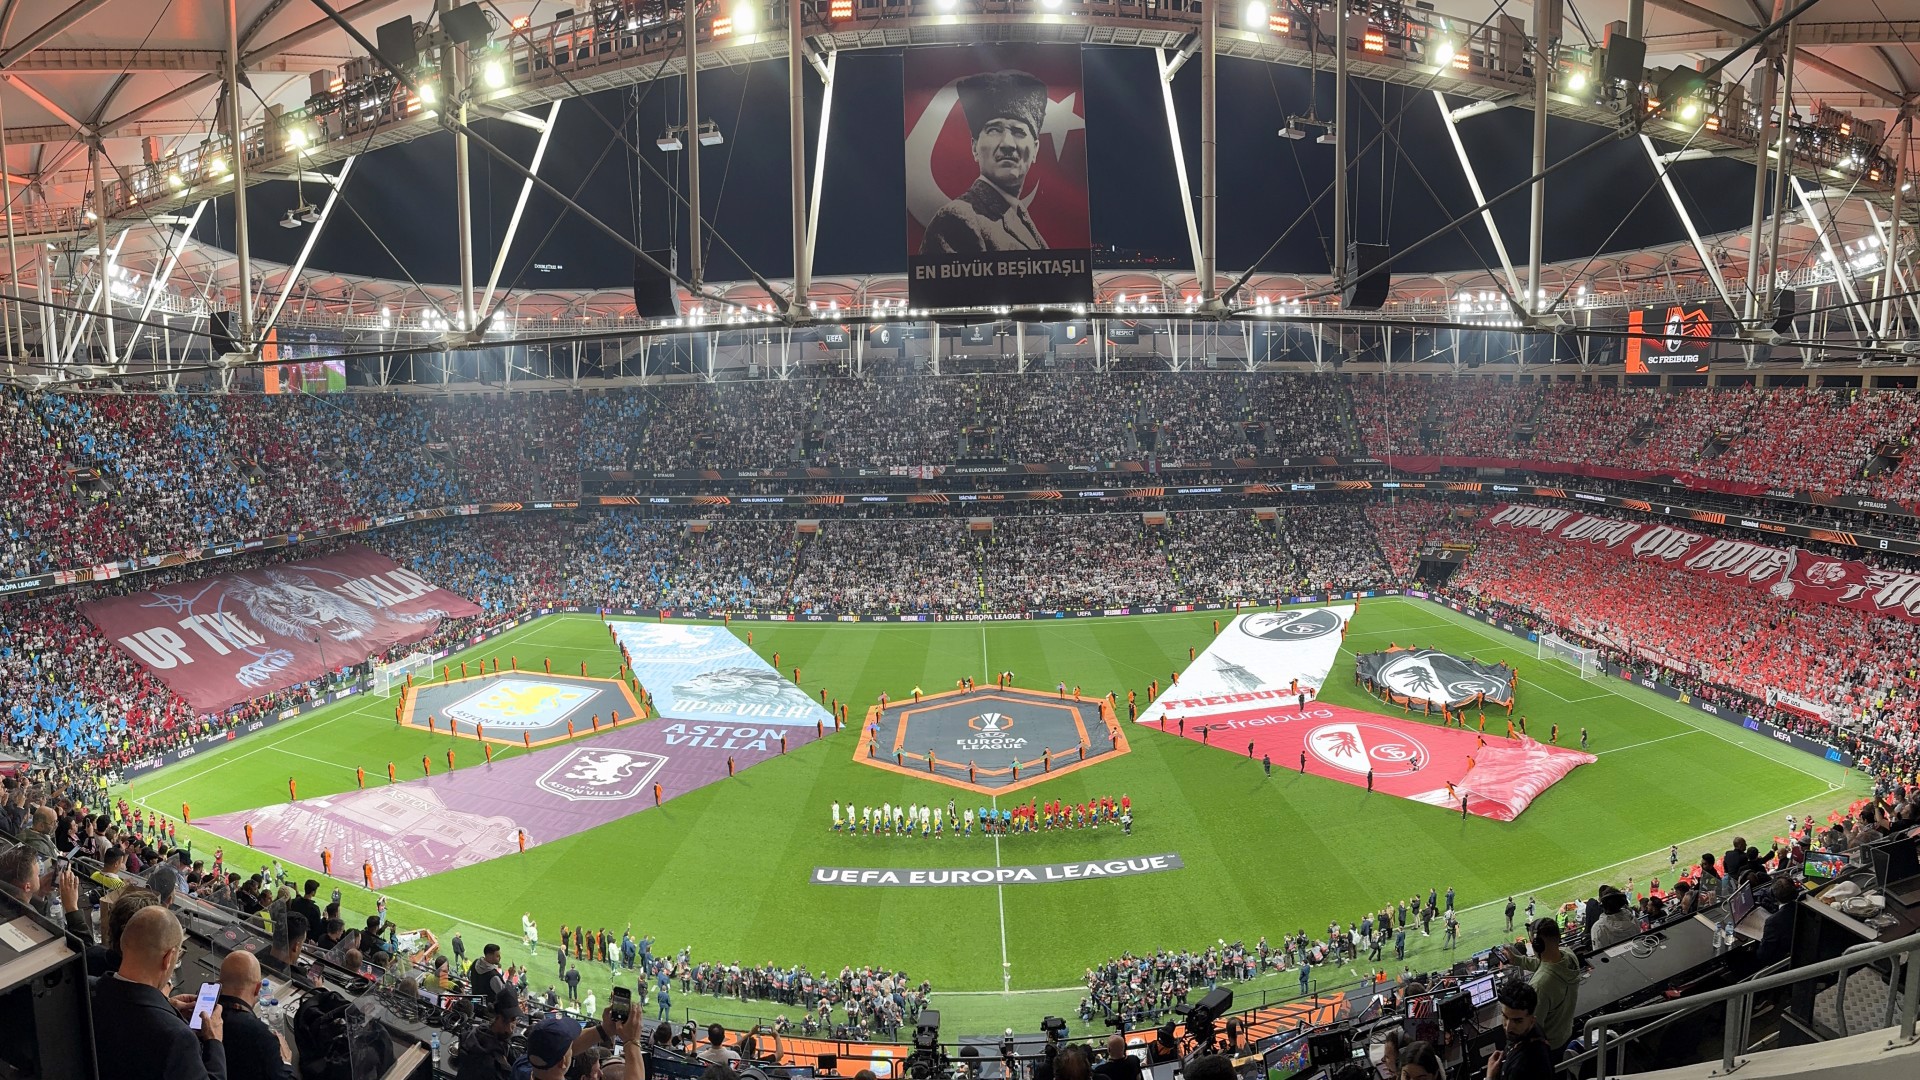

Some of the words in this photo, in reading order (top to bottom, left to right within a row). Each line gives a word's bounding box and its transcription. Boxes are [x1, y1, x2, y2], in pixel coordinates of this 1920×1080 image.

[915, 265, 936, 280] EN
[940, 259, 993, 278] BÜYÜK
[997, 257, 1085, 278] BEŞİKTAŞLI
[826, 334, 843, 342] UEFA
[1648, 356, 1658, 364] SC
[1658, 354, 1699, 364] FREIBURG
[1864, 500, 1887, 509] STRAUSS
[1759, 523, 1773, 531] FINAL
[17, 579, 40, 589] LEAGUE
[994, 612, 1021, 620] LEAGUE
[118, 625, 195, 669] UP
[177, 611, 266, 656] THE
[1544, 639, 1555, 649] UEFA
[1641, 678, 1655, 689] UEFA
[312, 698, 325, 708] UEFA
[1682, 694, 1691, 704] ALL
[671, 699, 707, 713] UP
[706, 702, 737, 714] THE
[735, 703, 813, 719] VILLA!
[1702, 702, 1718, 715] UEFA
[453, 709, 493, 724] ASTON
[248, 720, 264, 732] UEFA
[1749, 720, 1759, 731] ALL
[227, 730, 236, 741] ALL
[661, 723, 789, 741] ASTON
[1773, 729, 1791, 743] UEFA
[665, 733, 767, 751] VILLA
[956, 737, 1028, 745] EUROPA
[177, 747, 195, 759] UEFA
[1829, 747, 1842, 762] ALL
[547, 781, 585, 795] ASTON
[388, 789, 433, 811] ASTON
[815, 868, 901, 884] UEFA
[908, 867, 1039, 884] EUROPA
